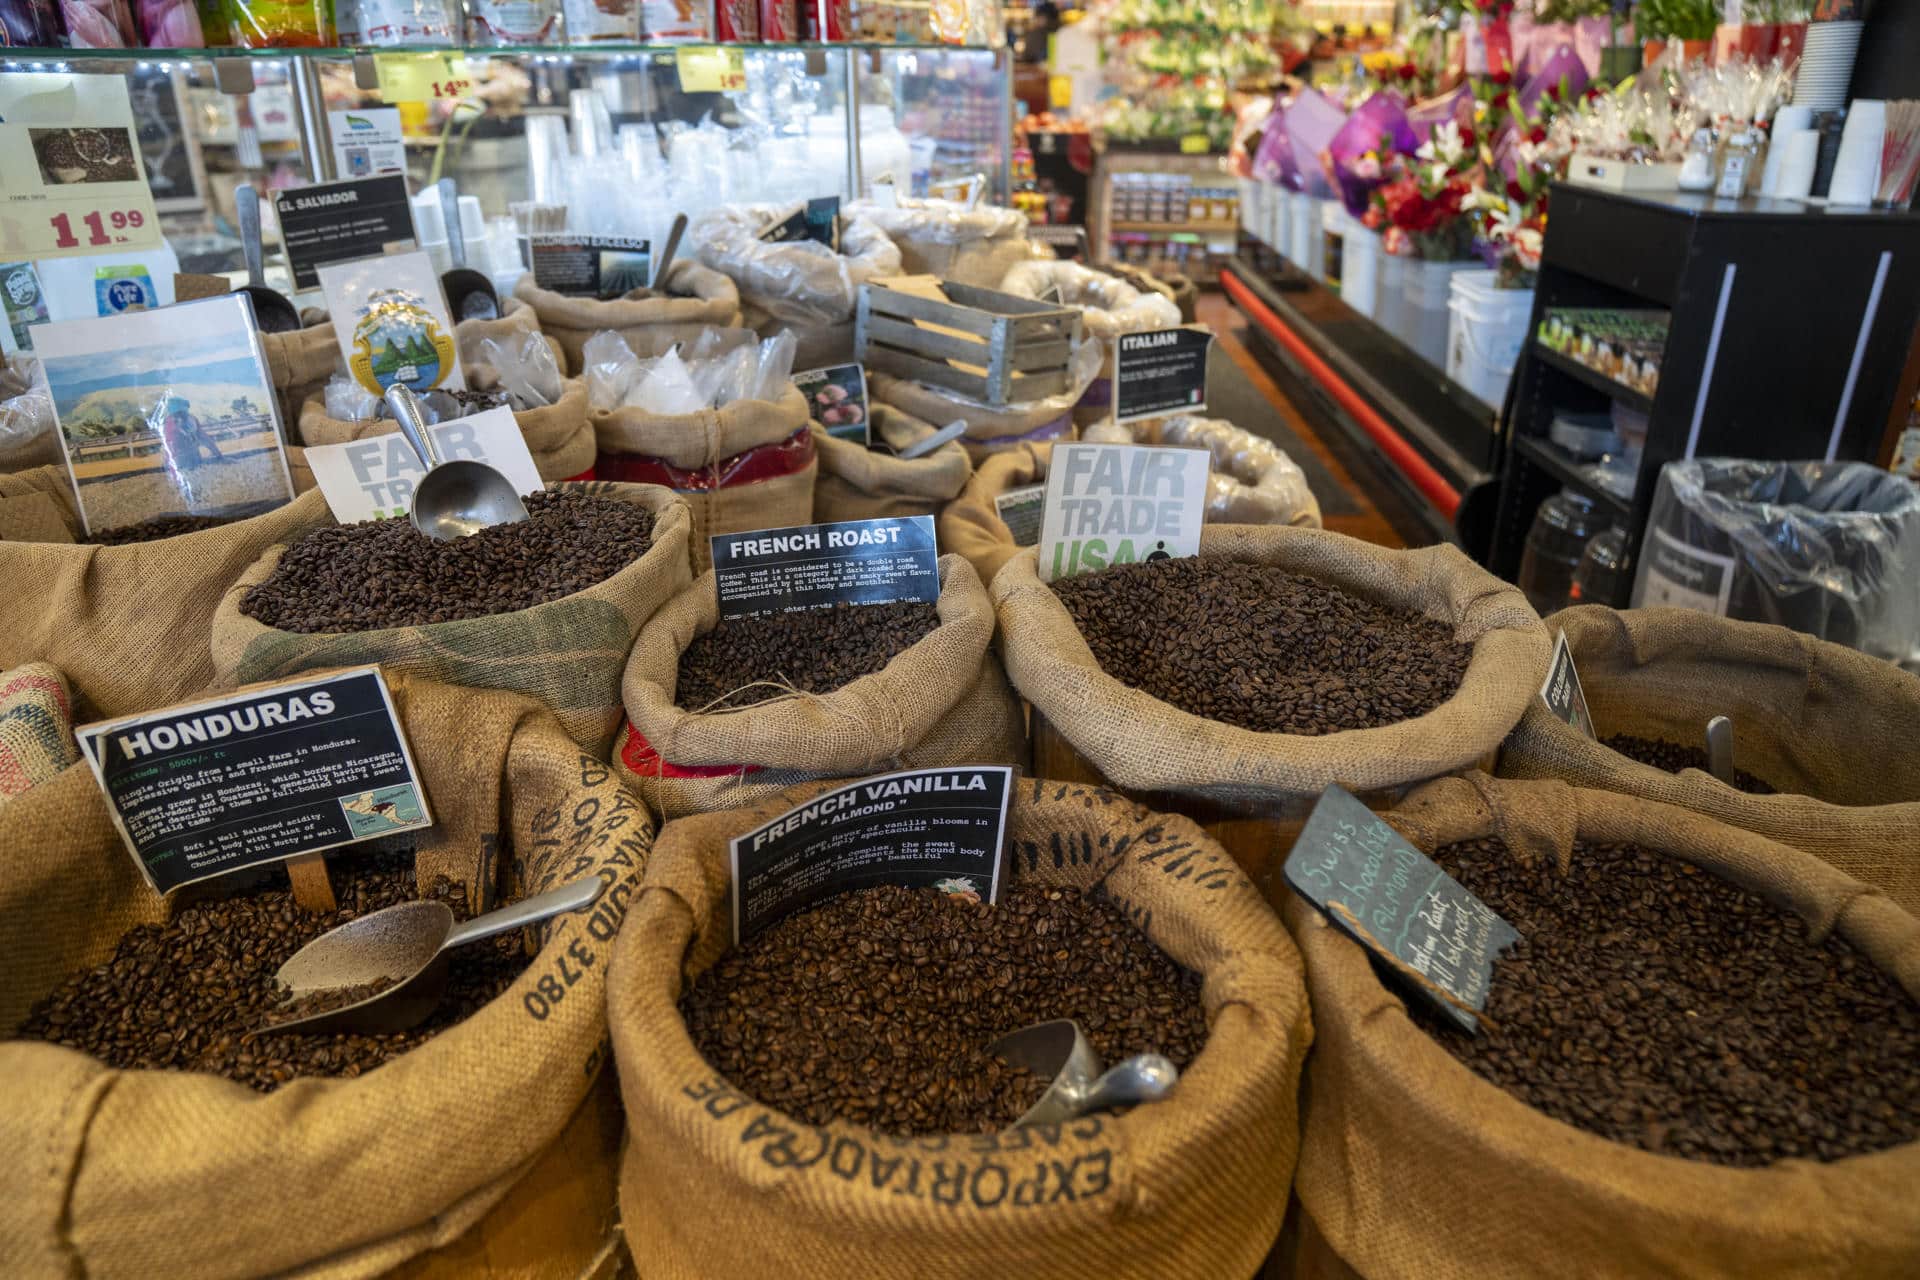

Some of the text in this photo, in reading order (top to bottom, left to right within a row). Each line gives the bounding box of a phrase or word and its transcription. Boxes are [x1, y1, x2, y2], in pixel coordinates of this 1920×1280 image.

[279, 190, 359, 212] EL SALVADOR
[1122, 331, 1178, 351] ITALIAN
[345, 422, 489, 483] FAR
[1062, 447, 1188, 497] FAIR
[1060, 498, 1184, 536] TRADE
[730, 526, 901, 558] FRENCH ROAST
[1051, 538, 1136, 583] USA
[720, 572, 747, 581] French
[750, 569, 768, 577] roast
[784, 562, 829, 573] considered
[867, 557, 893, 565] double
[721, 581, 778, 594] characterized
[781, 580, 791, 588] by
[807, 575, 839, 584] intense
[751, 576, 768, 584] This
[794, 570, 829, 580] category
[721, 589, 770, 601] accompanied
[773, 587, 783, 595] by
[816, 582, 835, 590] body
[118, 691, 336, 760] HONDURAS
[118, 782, 153, 803] Single
[158, 774, 193, 789] Origin
[198, 766, 221, 778] from
[236, 757, 264, 770] small
[269, 751, 292, 761] Farm
[297, 747, 308, 756] in
[312, 738, 361, 752] Honduras.
[214, 751, 226, 760] ft
[121, 757, 305, 810] Impressive Quality and Freshness.
[128, 805, 163, 823] Coffees
[168, 797, 197, 811] grown
[201, 792, 214, 801] in
[272, 771, 300, 784] which
[303, 763, 342, 777] borders
[347, 751, 401, 768] Nicaragua,
[131, 820, 144, 831] El
[148, 805, 193, 822] Salvador
[199, 799, 216, 809] and
[220, 787, 275, 803] Guatemala,
[280, 773, 328, 791] generally
[333, 766, 366, 779] having
[134, 822, 163, 838] notes
[168, 804, 225, 825] describing
[229, 797, 252, 808] them
[272, 779, 332, 799] full-bodied
[336, 773, 358, 785] with
[374, 765, 401, 777] sweet
[753, 774, 987, 852] FRENCH VANILLA
[866, 824, 879, 832] of
[885, 819, 927, 829] vanilla
[975, 818, 988, 826] in
[138, 831, 156, 846] and
[159, 821, 184, 834] mild
[183, 841, 205, 852] Soft
[218, 831, 240, 842] Well
[242, 822, 283, 836] Balanced
[286, 813, 325, 827] acidity.
[186, 848, 219, 861] Medium
[220, 840, 243, 853] body
[246, 834, 268, 845] with
[280, 827, 301, 838] hint
[308, 823, 315, 831] of
[190, 850, 241, 869] Chocolate.
[254, 843, 271, 852] bit
[274, 836, 299, 848] Nutty
[317, 828, 341, 839] well.
[861, 825, 931, 840] spectacular.
[888, 853, 942, 861] beautiful
[960, 847, 985, 857] body
[1302, 820, 1356, 888] Swiss
[1372, 848, 1419, 933] ALMOND
[524, 937, 596, 1021] 3780
